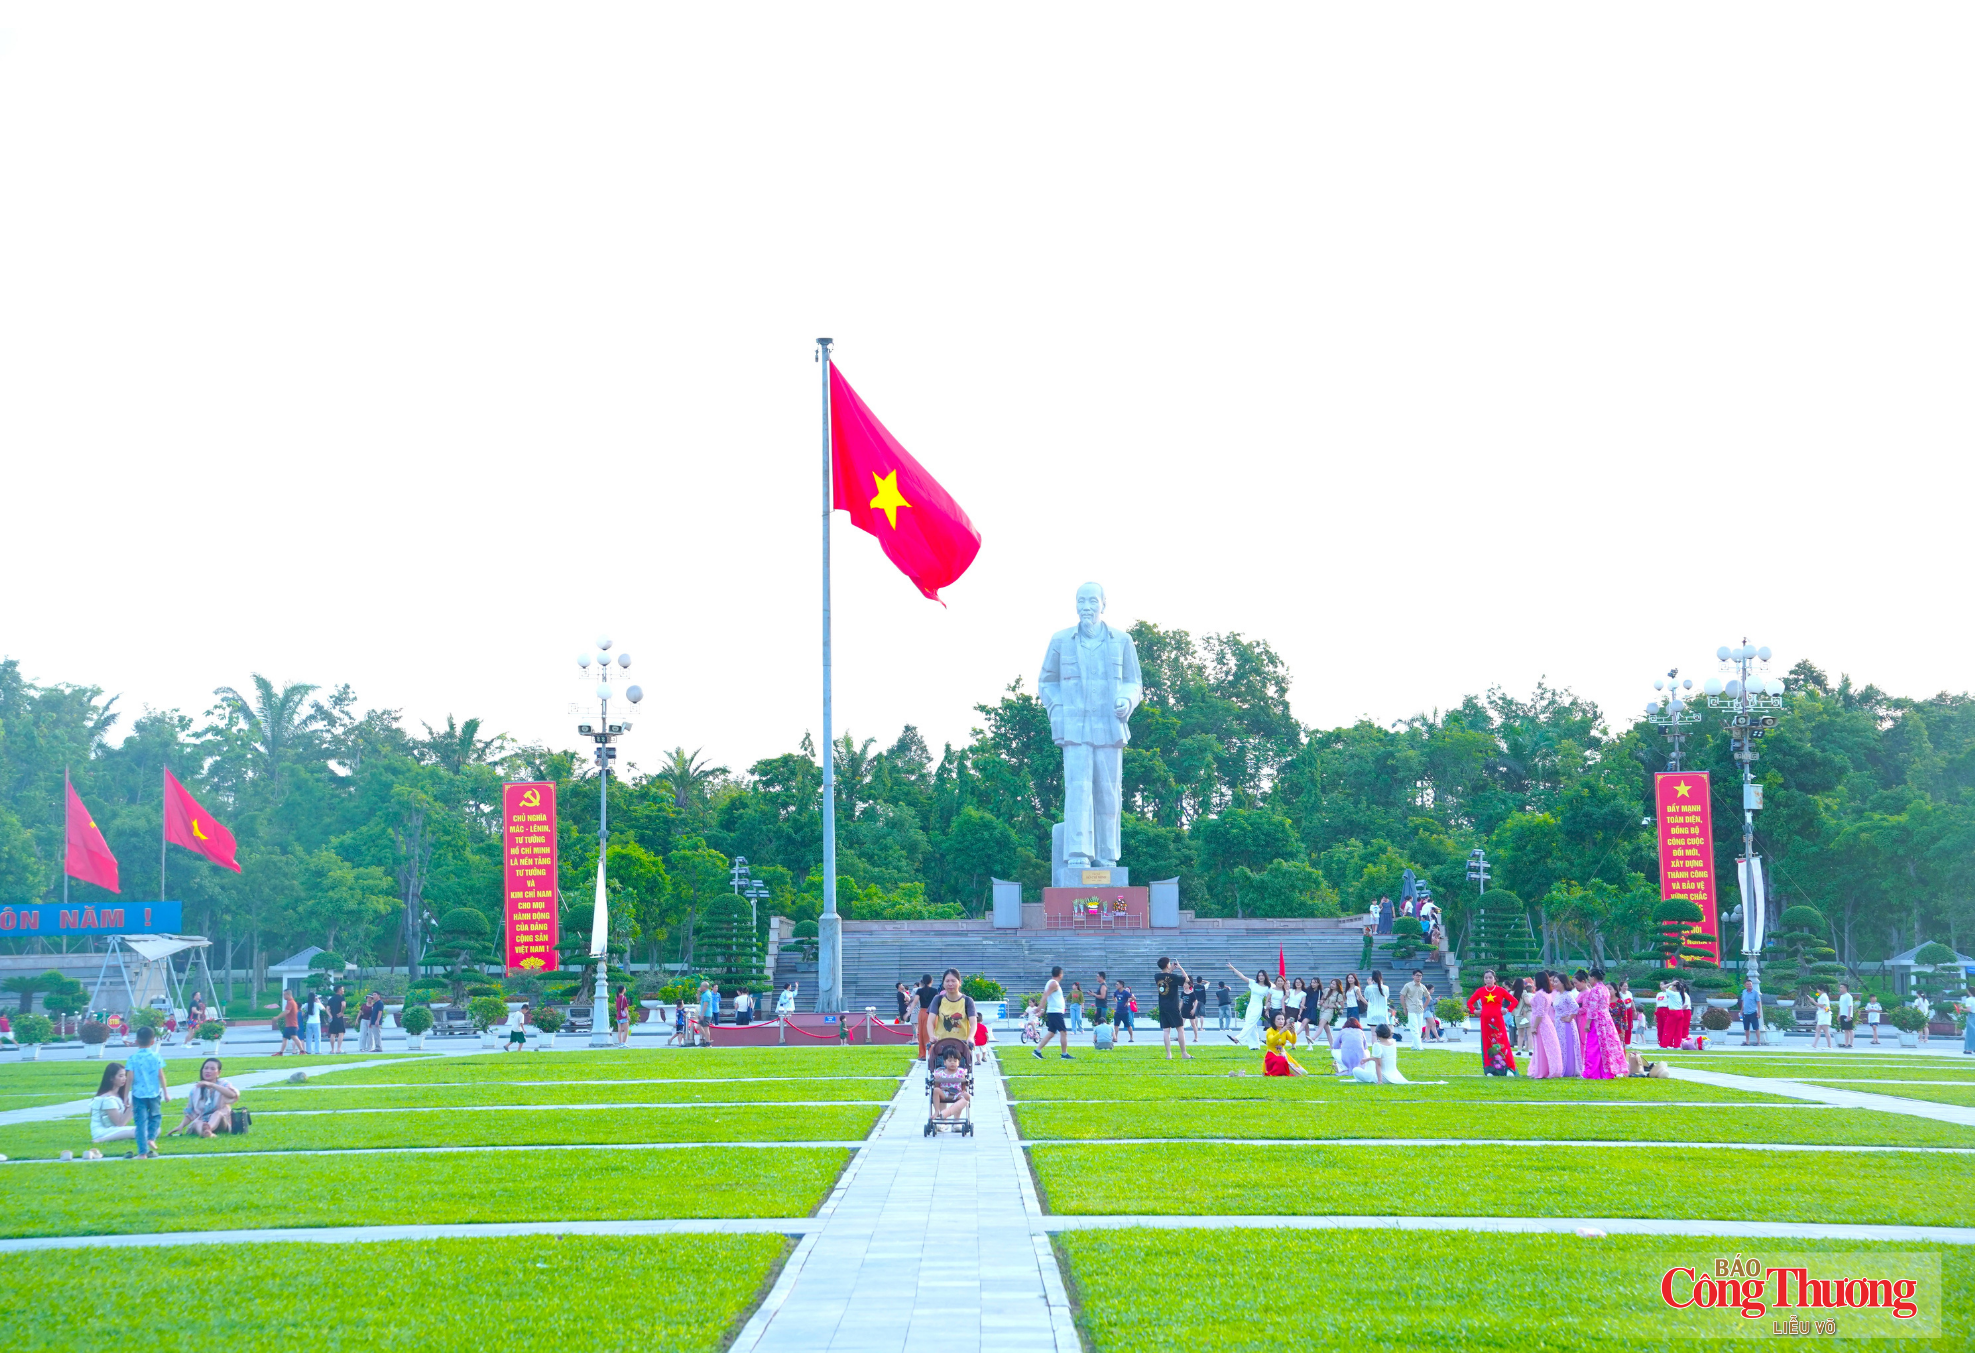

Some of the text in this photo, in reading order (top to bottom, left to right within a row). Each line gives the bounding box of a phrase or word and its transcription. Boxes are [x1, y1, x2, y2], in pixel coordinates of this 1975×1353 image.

[1681, 805, 1701, 813] MẠNH
[513, 813, 547, 822] CHỦ NGHĨA
[1667, 815, 1703, 824] TOÀN DIỆN,
[510, 825, 524, 833] MÁC
[530, 824, 551, 833] LÊNIN,
[1690, 826, 1700, 835] BỘ
[524, 834, 545, 843] TƯỞNG
[1668, 837, 1704, 846] CÔNG CUỘC
[521, 846, 531, 854] CHÍ
[510, 857, 518, 865] LÀ
[535, 856, 551, 865] TẢNG
[1671, 859, 1703, 868] XÂY DỰNG
[525, 867, 546, 876] TƯỞNG
[1667, 870, 1708, 878] THÀNH CÔNG
[527, 879, 535, 887] VÀ
[1672, 880, 1705, 890] VÀ BẢO VỆ
[525, 889, 535, 898] CHỈ
[532, 902, 545, 910] MỌI
[59, 905, 125, 928] NĂM
[144, 908, 152, 926] !
[514, 912, 550, 921] HÀNH ĐỘNG
[516, 922, 548, 931] CỦA ĐẢNG
[516, 933, 548, 943] CỘNG SẢN
[515, 945, 528, 954] VIỆT
